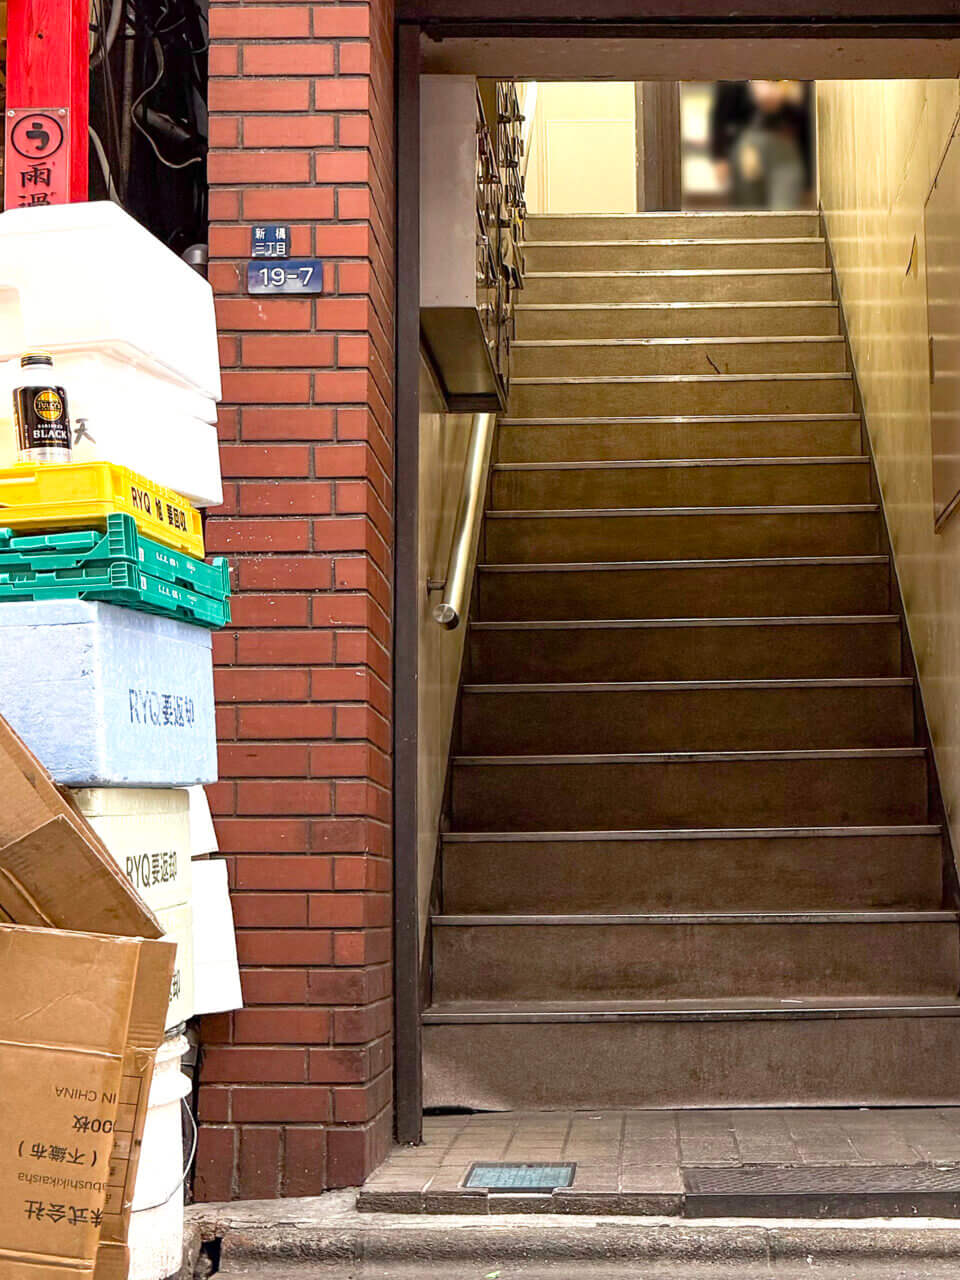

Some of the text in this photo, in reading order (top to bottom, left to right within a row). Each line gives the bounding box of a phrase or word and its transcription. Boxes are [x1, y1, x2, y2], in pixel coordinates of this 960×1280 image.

[25, 122, 50, 151] う
[255, 227, 286, 240] 新橋
[255, 242, 286, 255] 三丁目
[258, 267, 314, 287] 19-7
[33, 430, 68, 439] BLACK
[55, 1085, 98, 1103] CHINA
